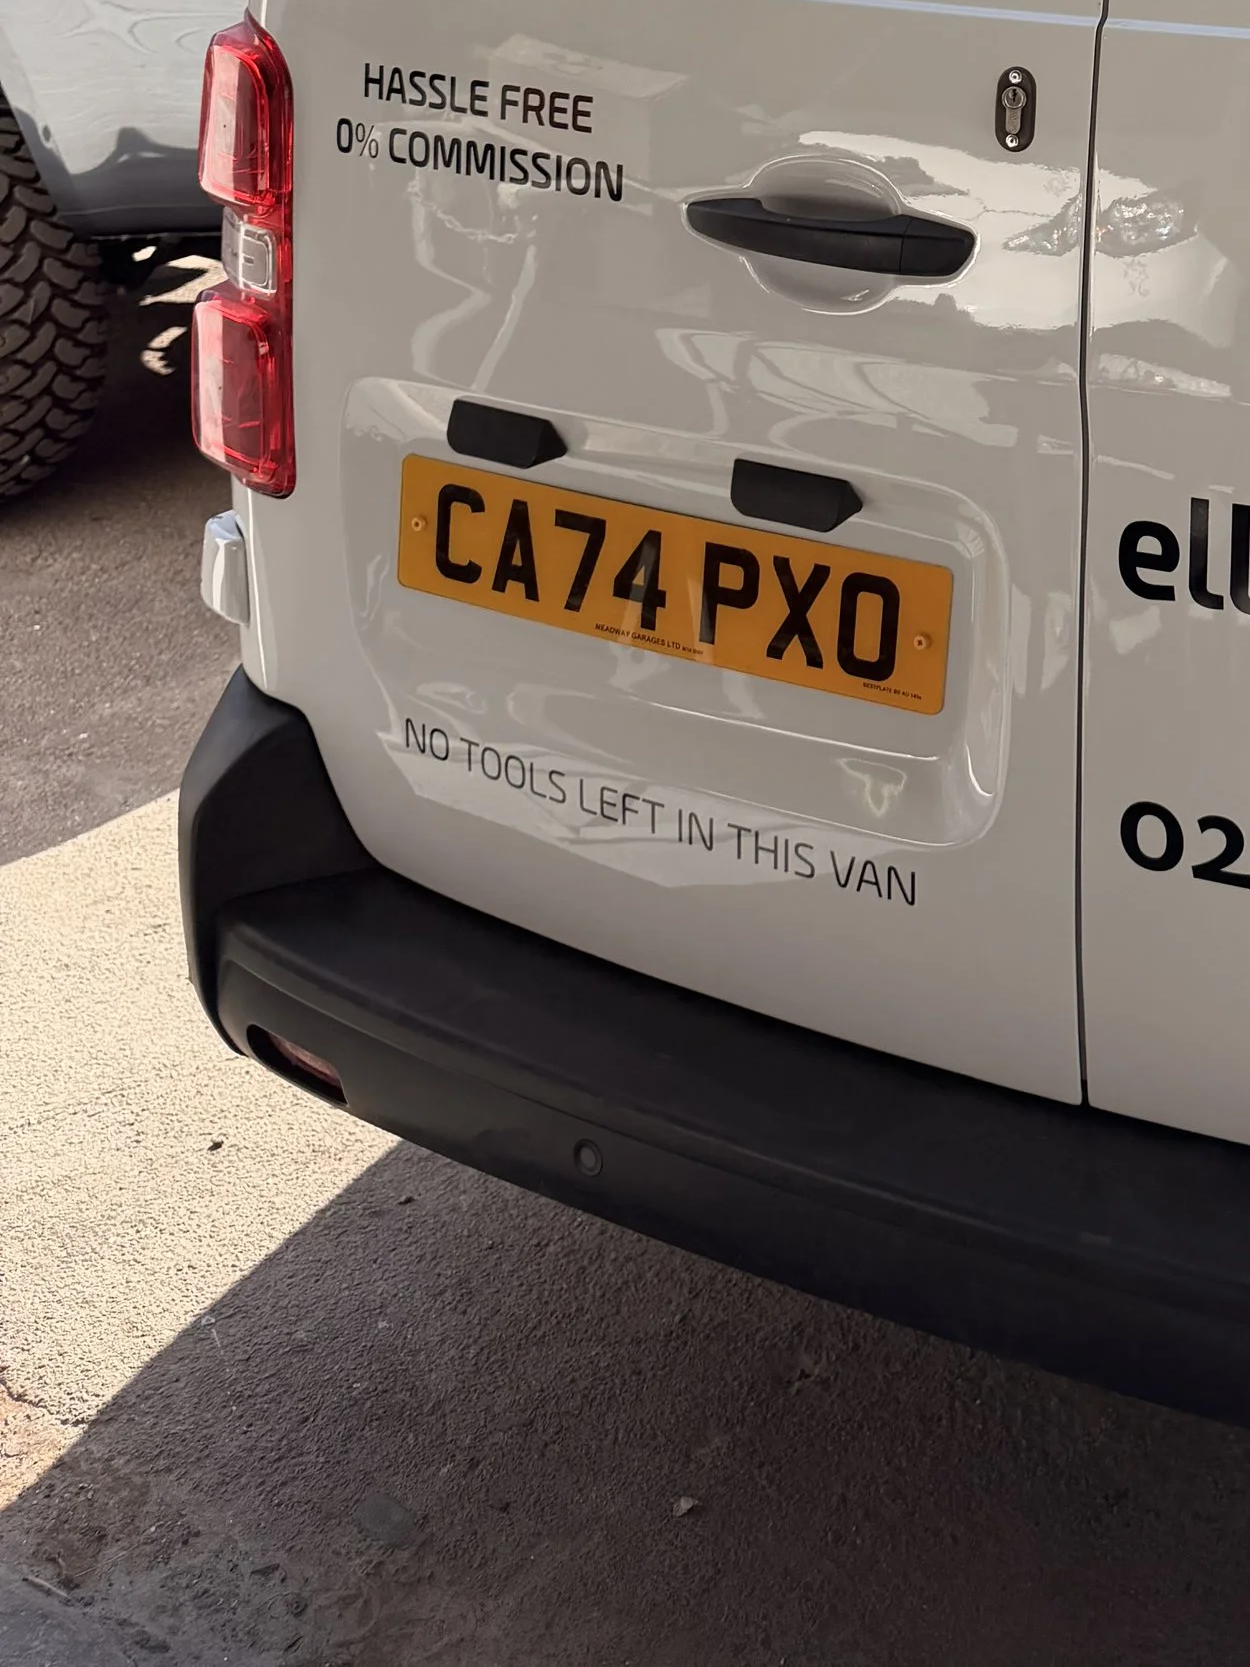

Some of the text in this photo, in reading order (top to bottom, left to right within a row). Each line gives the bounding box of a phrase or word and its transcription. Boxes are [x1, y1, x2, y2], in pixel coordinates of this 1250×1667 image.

[363, 62, 594, 133] HASSLE FREE
[335, 117, 624, 202] 0% COMMISSION
[434, 484, 901, 682] CA74 PXO
[631, 632, 666, 646] GARAGES
[667, 640, 681, 650] LTD
[404, 718, 917, 907] NO TOOLS LEFT IN THIS VAN
